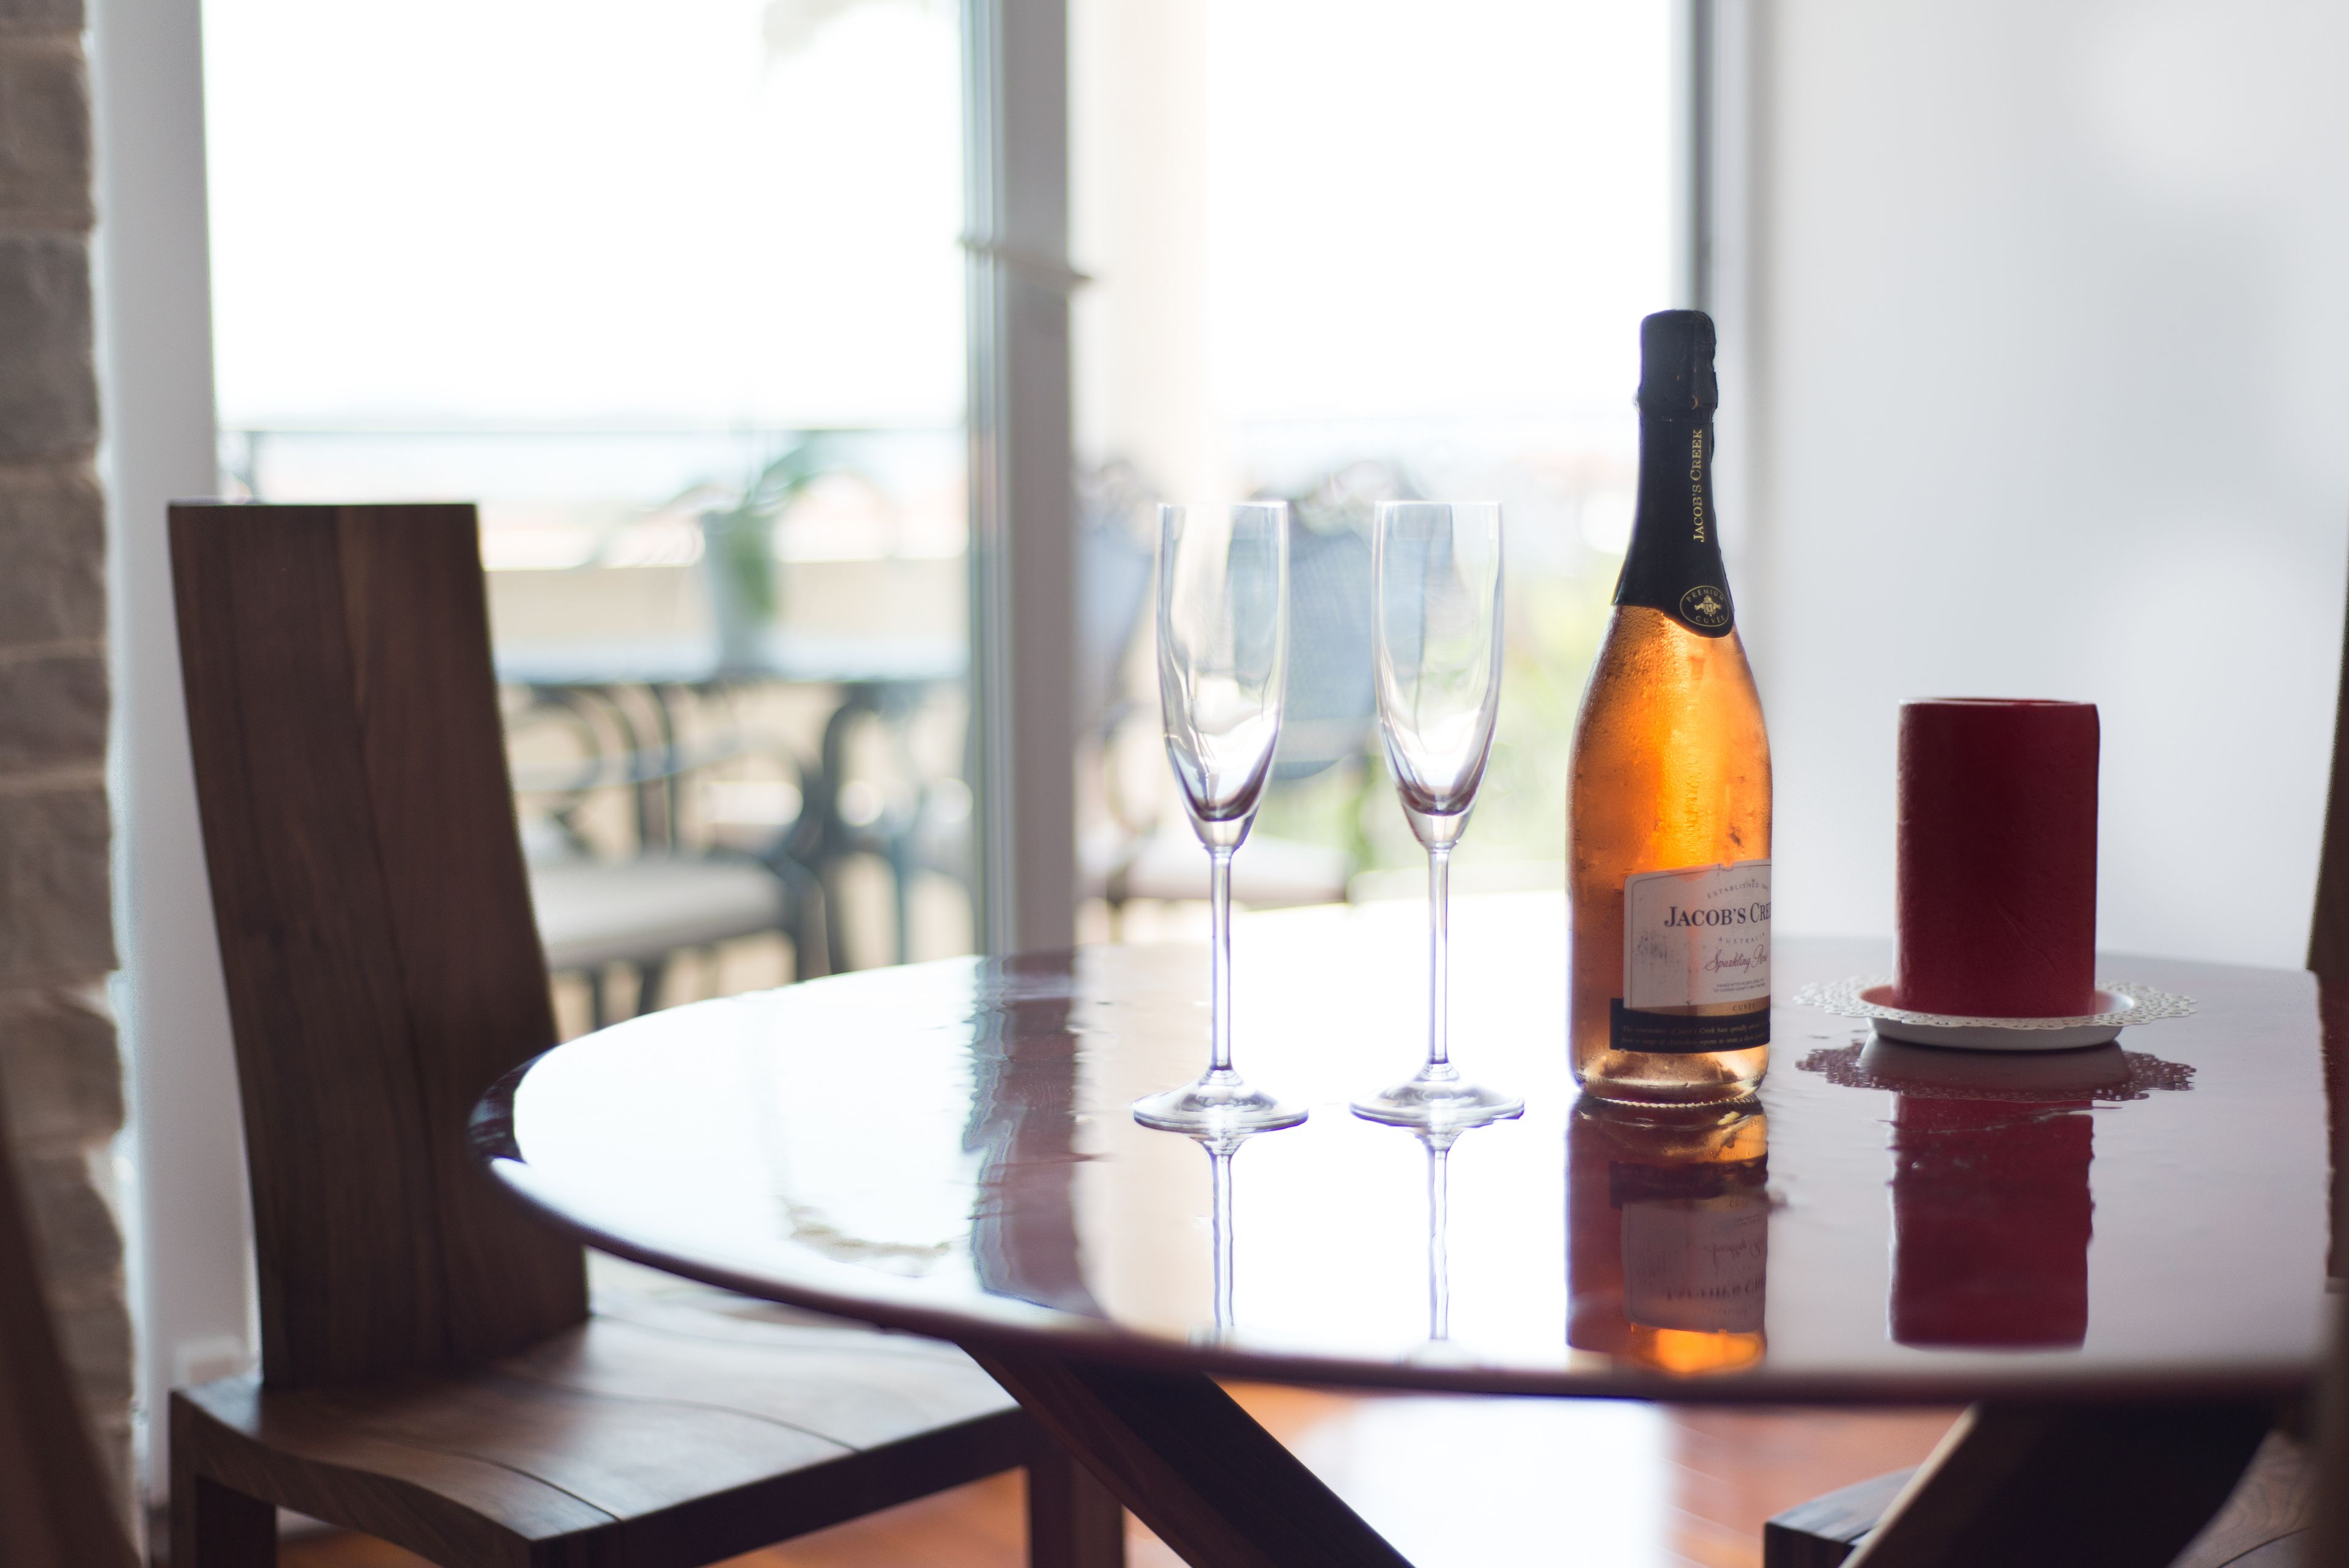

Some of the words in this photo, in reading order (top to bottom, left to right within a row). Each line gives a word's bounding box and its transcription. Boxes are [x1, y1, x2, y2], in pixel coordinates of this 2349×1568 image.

[1690, 429, 1702, 481] CREEK
[1693, 485, 1705, 543] JACOB'S
[1686, 589, 1724, 602] PREMIUM
[1707, 882, 1759, 899] ESTABLISHED
[1664, 906, 1746, 927] JACOB'S
[1750, 901, 1772, 923] CRE
[1718, 932, 1765, 944] AUSTRALIA
[1702, 949, 1751, 973] Sparkling
